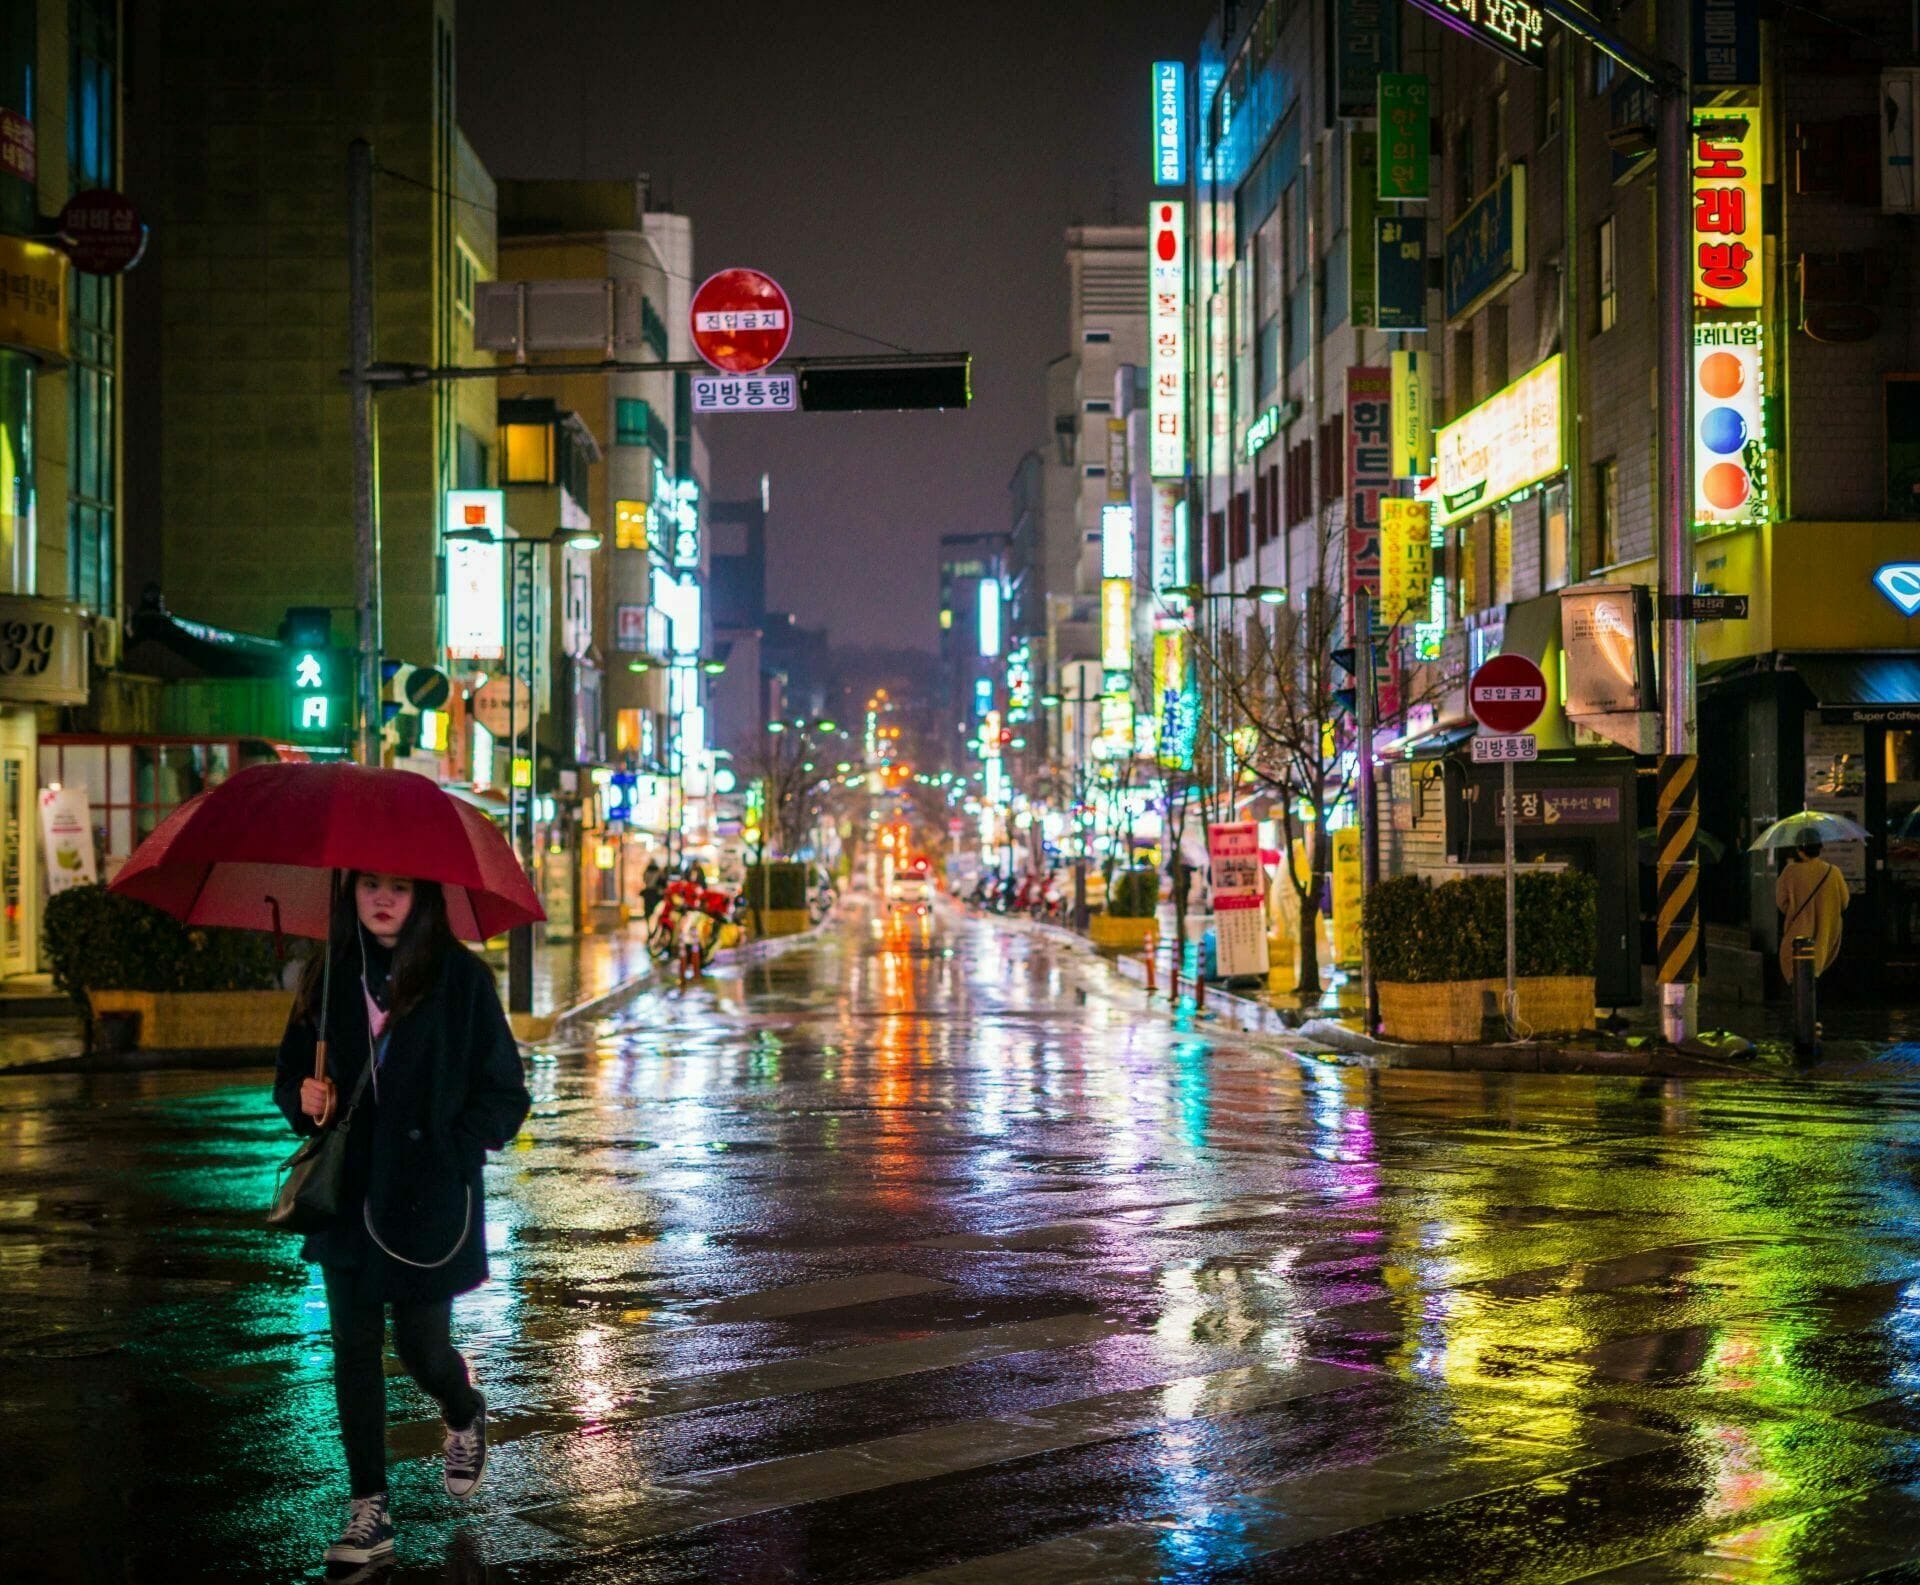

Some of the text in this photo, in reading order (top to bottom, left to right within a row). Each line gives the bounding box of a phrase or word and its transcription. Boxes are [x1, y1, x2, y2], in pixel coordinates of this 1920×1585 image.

[1703, 0, 1737, 81] 룸텔
[1390, 108, 1417, 194] 한의원
[1695, 140, 1753, 289] 노래방
[704, 312, 778, 330] 진입금지
[696, 379, 793, 408] 일방통행
[1408, 383, 1418, 446] Lens Story
[1480, 687, 1537, 701] 진입금지
[1853, 711, 1885, 722] Super
[1474, 738, 1536, 760] 일방통행
